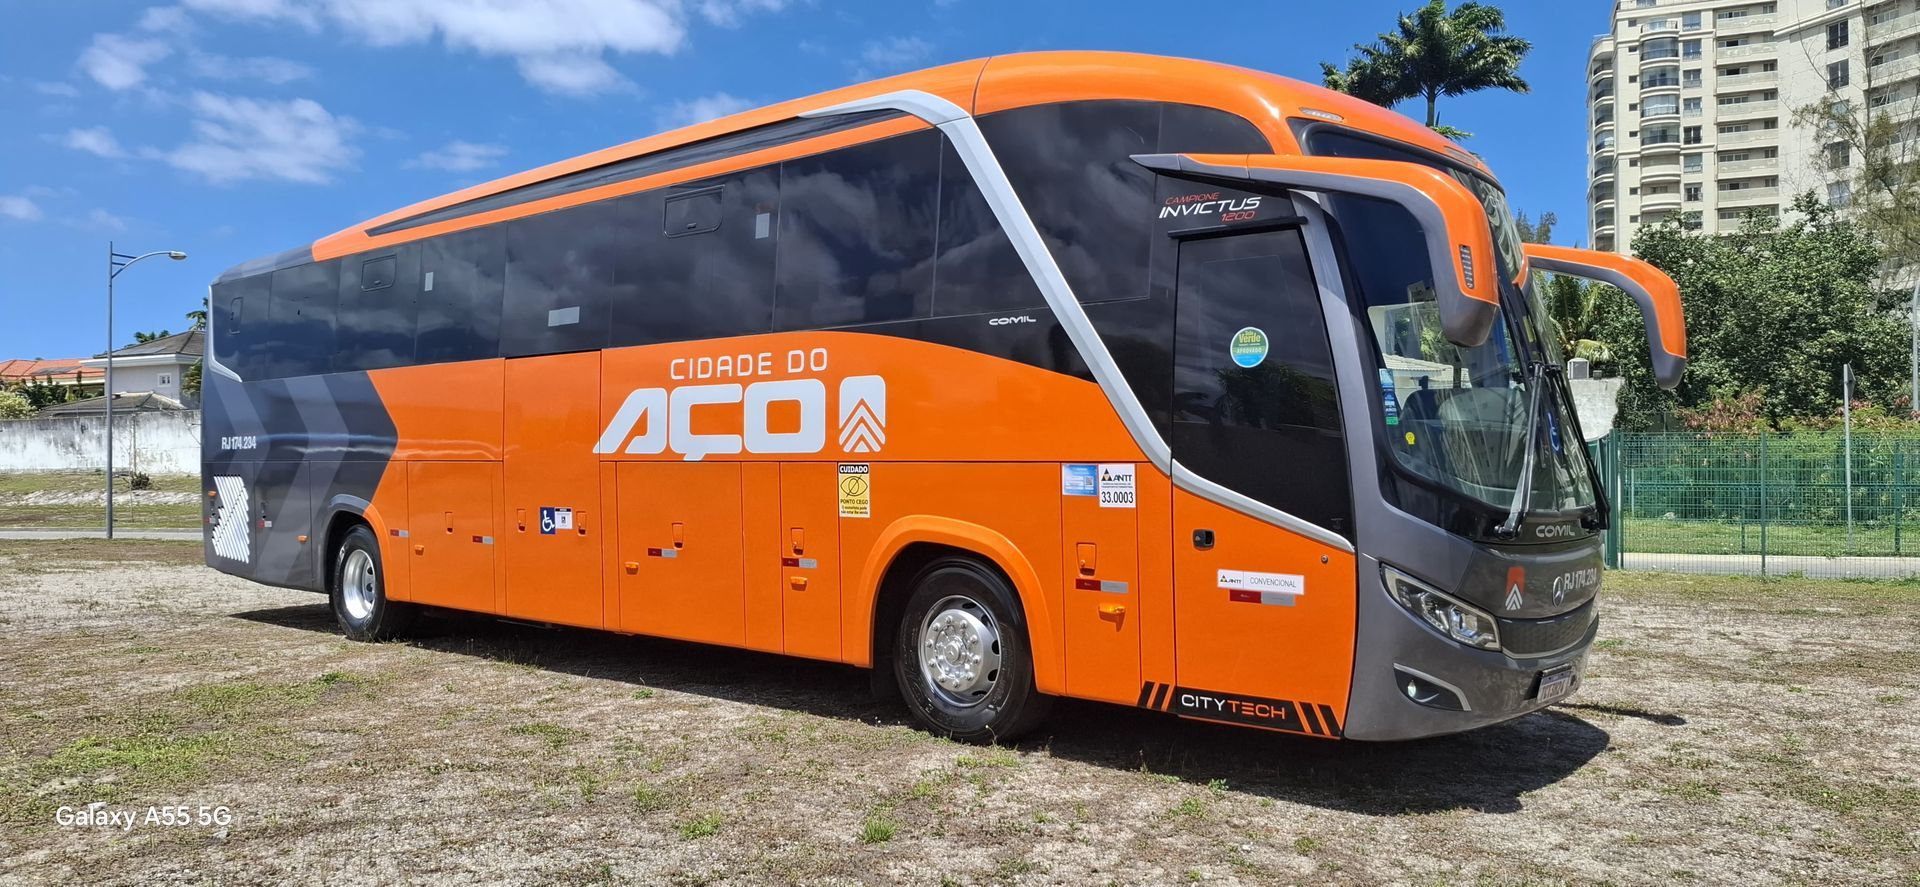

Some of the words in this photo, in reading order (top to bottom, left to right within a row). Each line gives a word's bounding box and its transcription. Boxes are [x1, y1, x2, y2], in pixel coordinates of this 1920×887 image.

[1165, 192, 1220, 205] CAMPIONE
[1159, 196, 1262, 219] INVICTUS
[1221, 211, 1255, 222] 1200
[989, 316, 1037, 326] COMIL
[1239, 333, 1261, 343] Verde
[670, 352, 773, 380] CIDADE
[787, 347, 828, 373] DO
[592, 378, 826, 461] AÇO
[221, 436, 231, 450] RJ
[232, 436, 257, 450] 174.234
[839, 465, 868, 473] CUIDADO
[1112, 474, 1133, 482] ANTT
[1101, 491, 1134, 504] 33.0003
[1535, 525, 1575, 538] COMIL
[1249, 577, 1297, 588] CONVENCIONAL
[1564, 573, 1575, 590] RJ
[1181, 694, 1286, 720] CITYTECH
